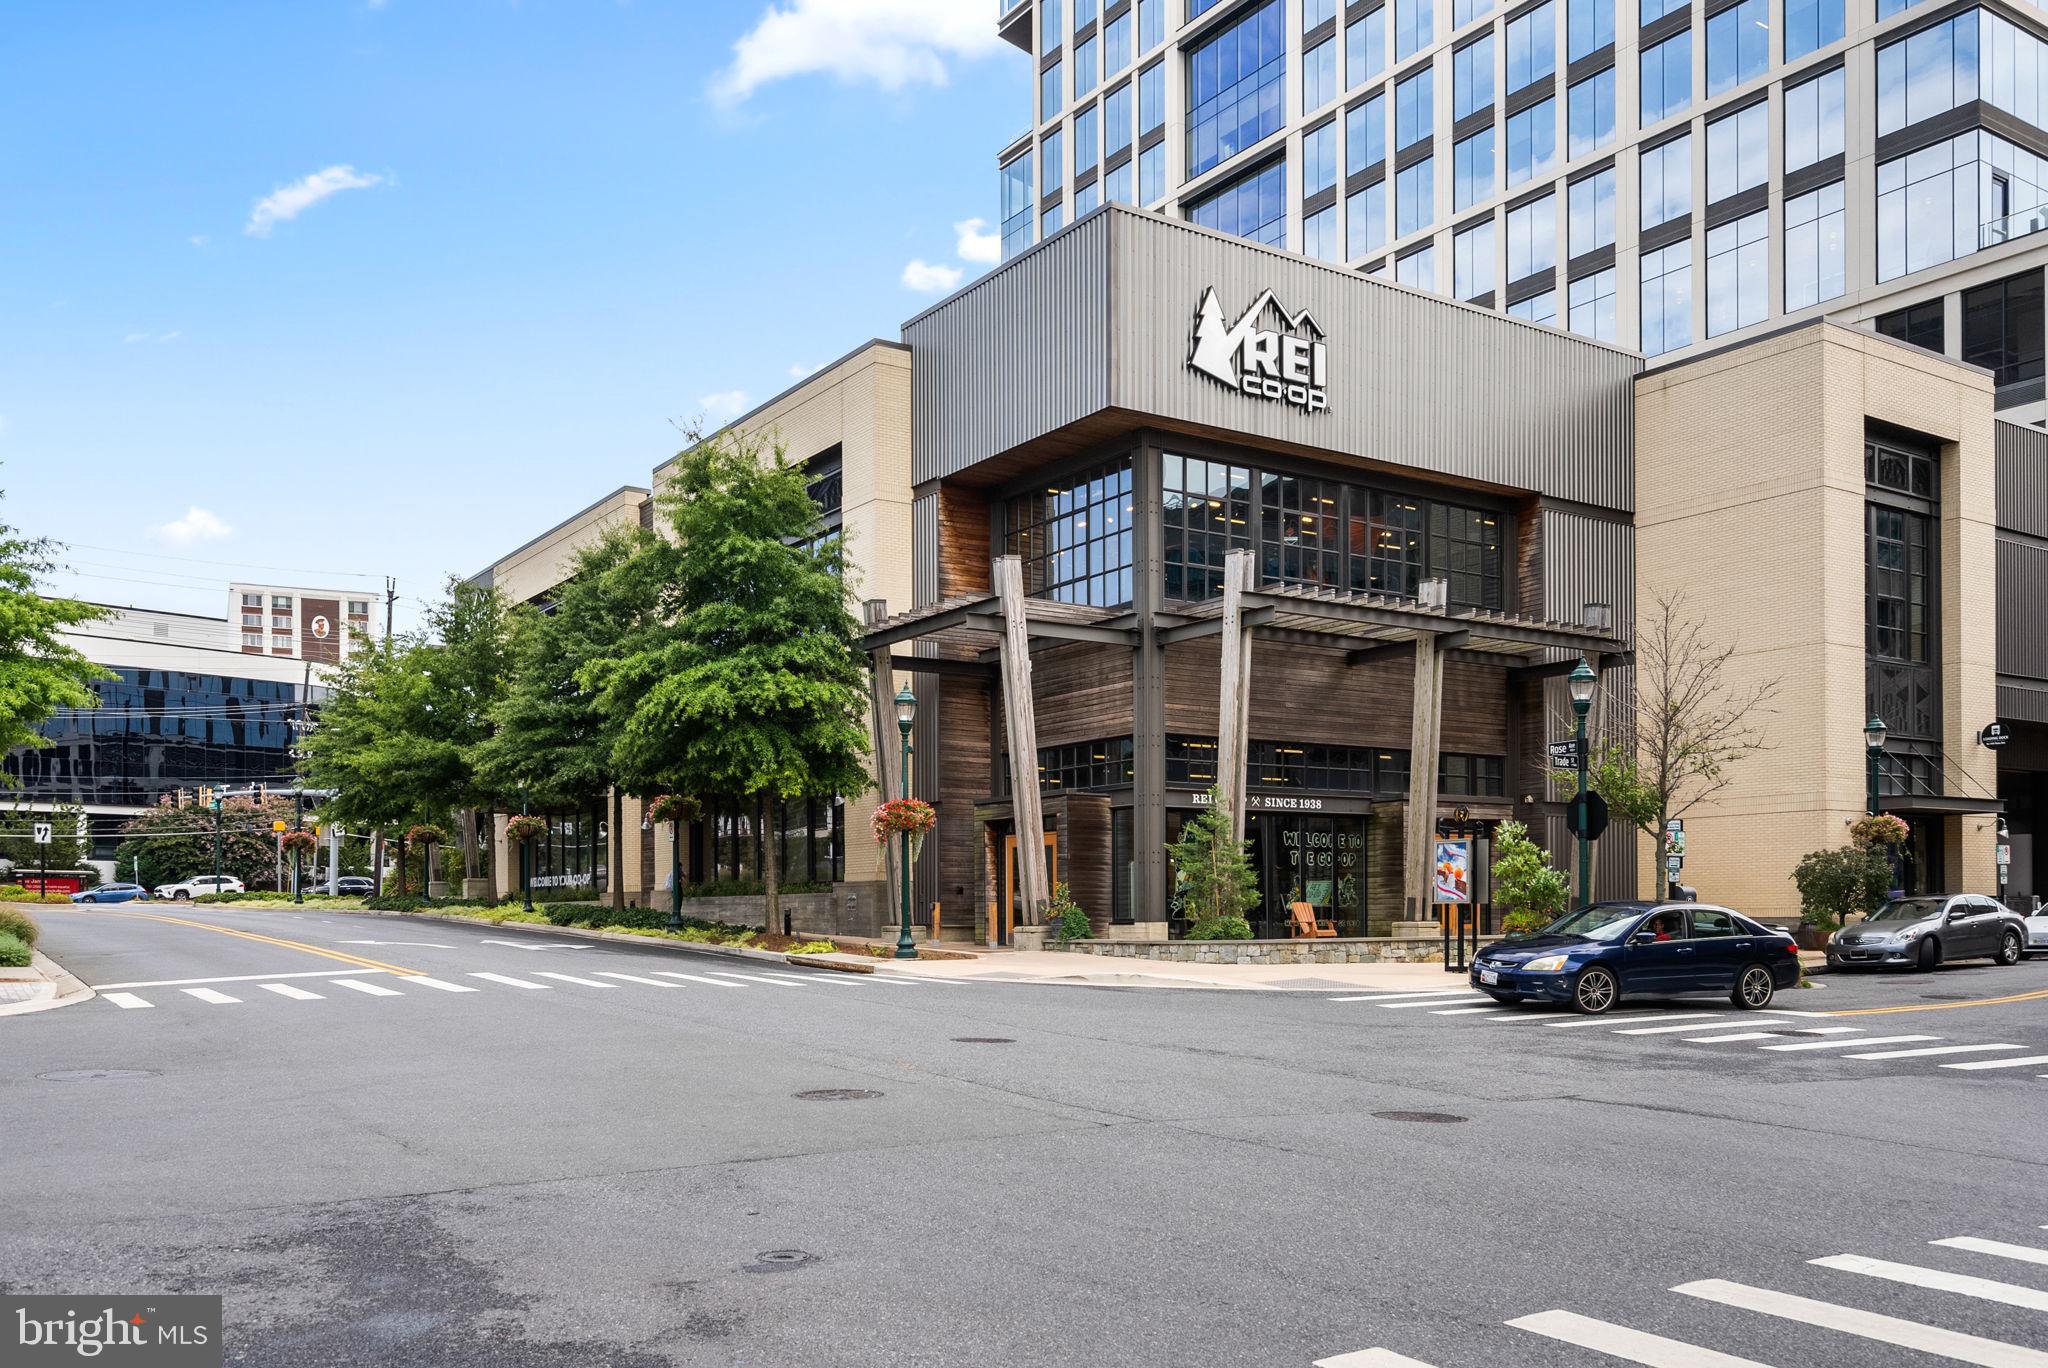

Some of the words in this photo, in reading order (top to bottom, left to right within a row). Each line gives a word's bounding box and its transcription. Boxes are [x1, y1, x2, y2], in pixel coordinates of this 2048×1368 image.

[1243, 327, 1327, 387] REI
[1550, 745, 1567, 754] Rose
[1554, 757, 1569, 767] Trade
[1192, 794, 1212, 804] REI
[1265, 797, 1297, 808] SINCE
[1299, 799, 1322, 809] 1938
[1348, 834, 1362, 848] TO
[552, 875, 558, 886] TO
